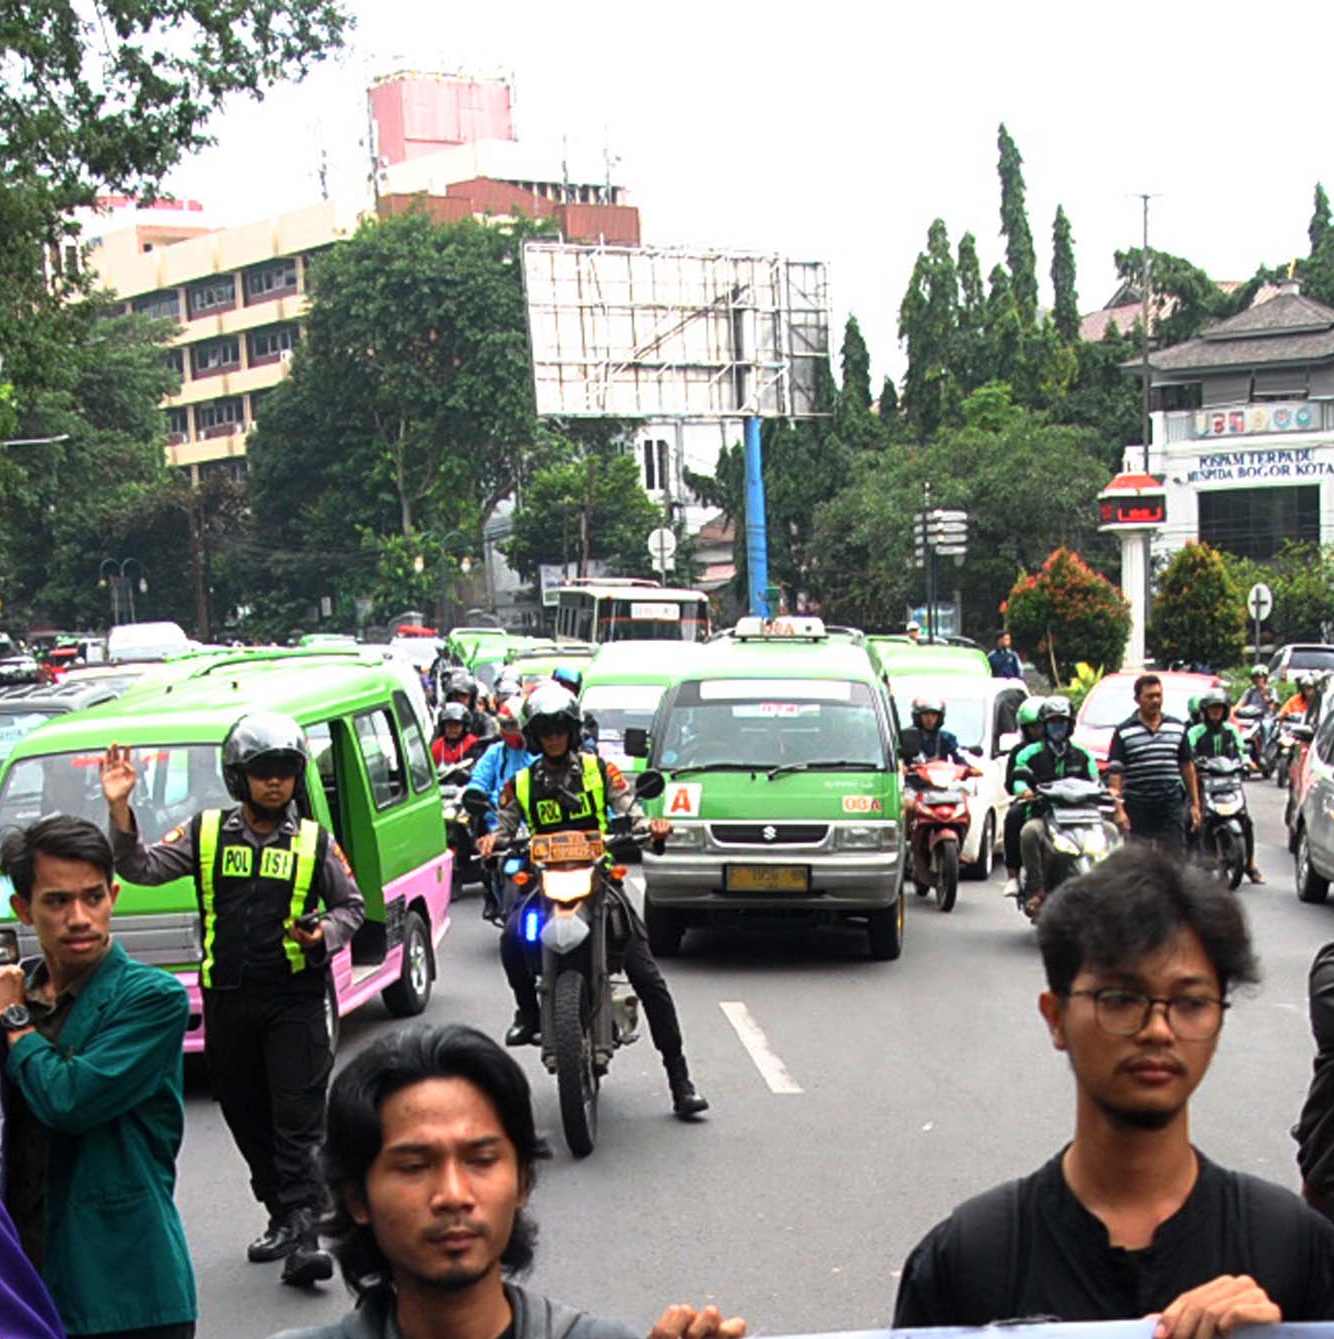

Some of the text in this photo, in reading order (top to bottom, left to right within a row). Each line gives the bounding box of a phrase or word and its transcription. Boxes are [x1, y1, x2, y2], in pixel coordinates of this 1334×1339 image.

[1236, 464, 1291, 479] BOGOR
[670, 787, 692, 813] A
[224, 849, 249, 873] POL
